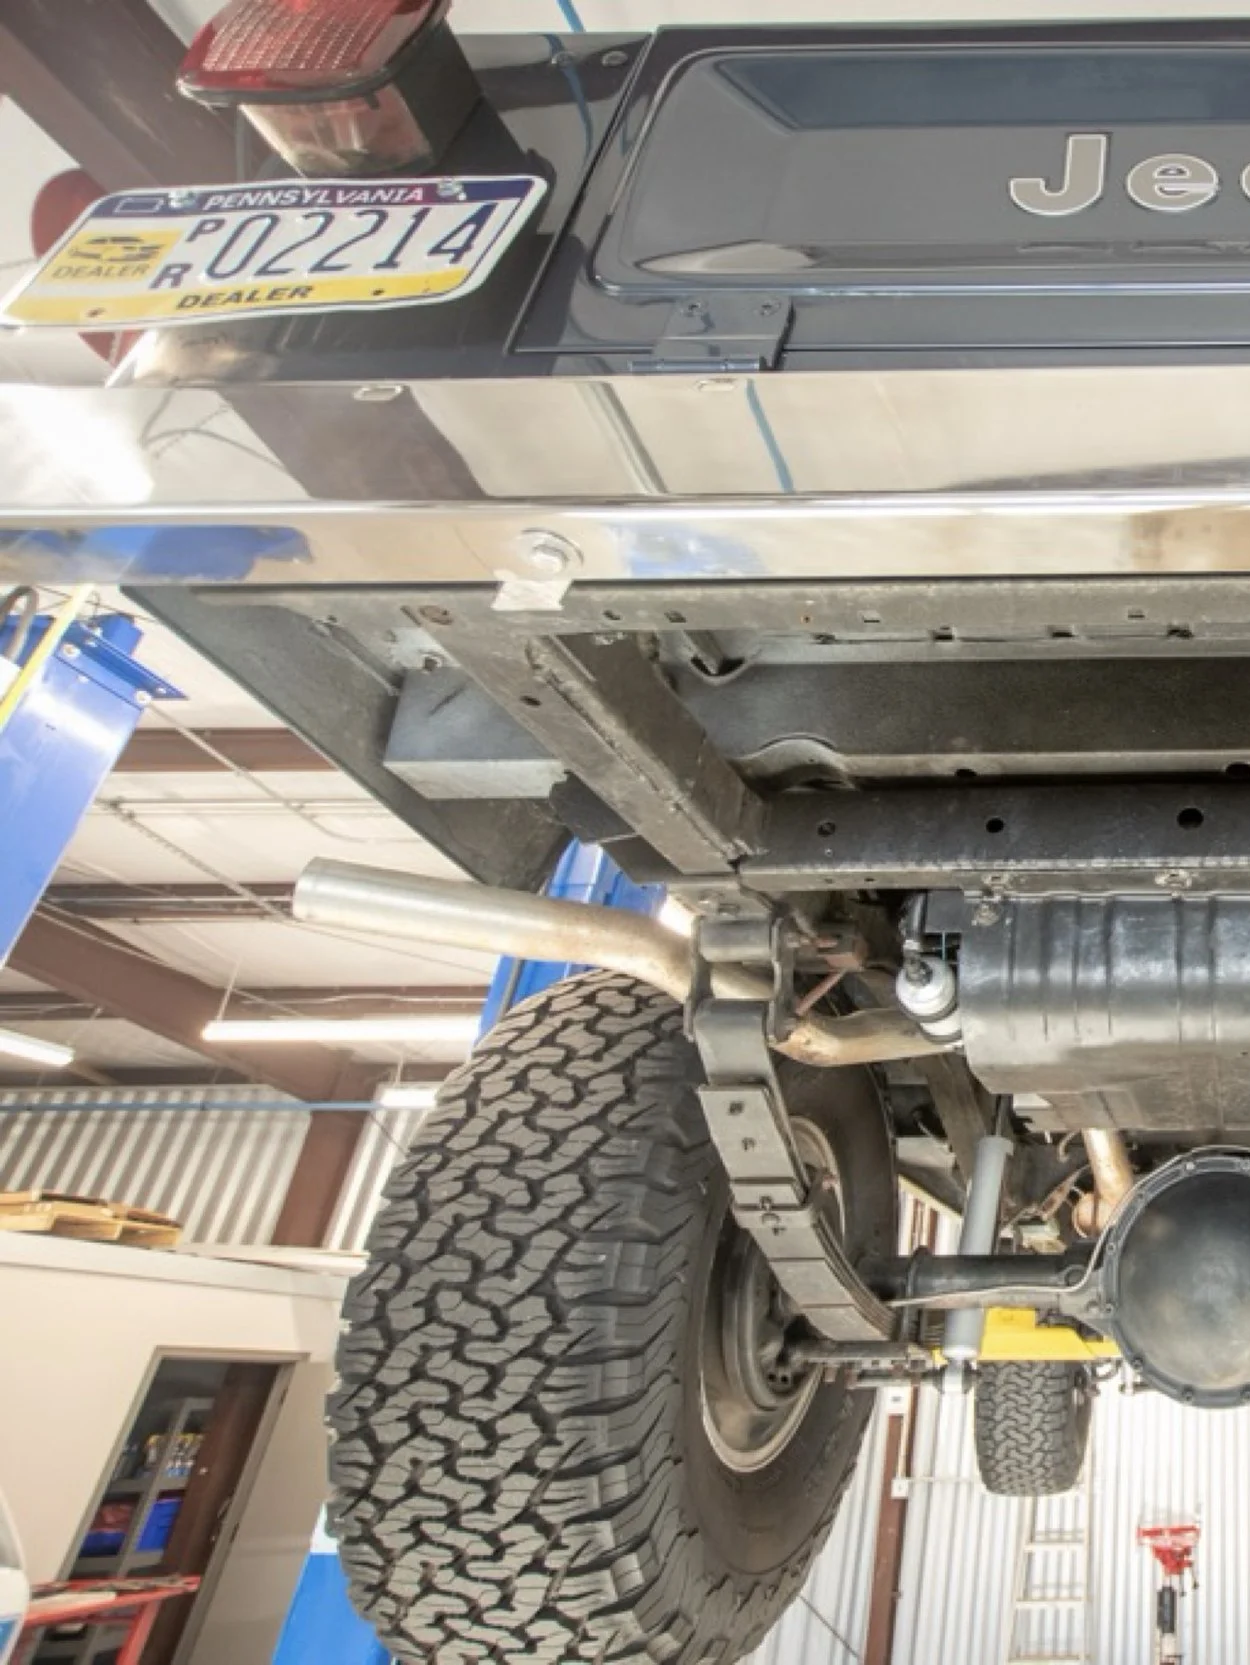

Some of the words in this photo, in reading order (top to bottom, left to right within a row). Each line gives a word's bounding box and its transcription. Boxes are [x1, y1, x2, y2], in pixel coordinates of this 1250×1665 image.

[202, 187, 424, 211] PENNSYLVANIA
[205, 203, 499, 280] 02214
[52, 265, 150, 279] DEALER
[176, 285, 314, 310] DEALER
